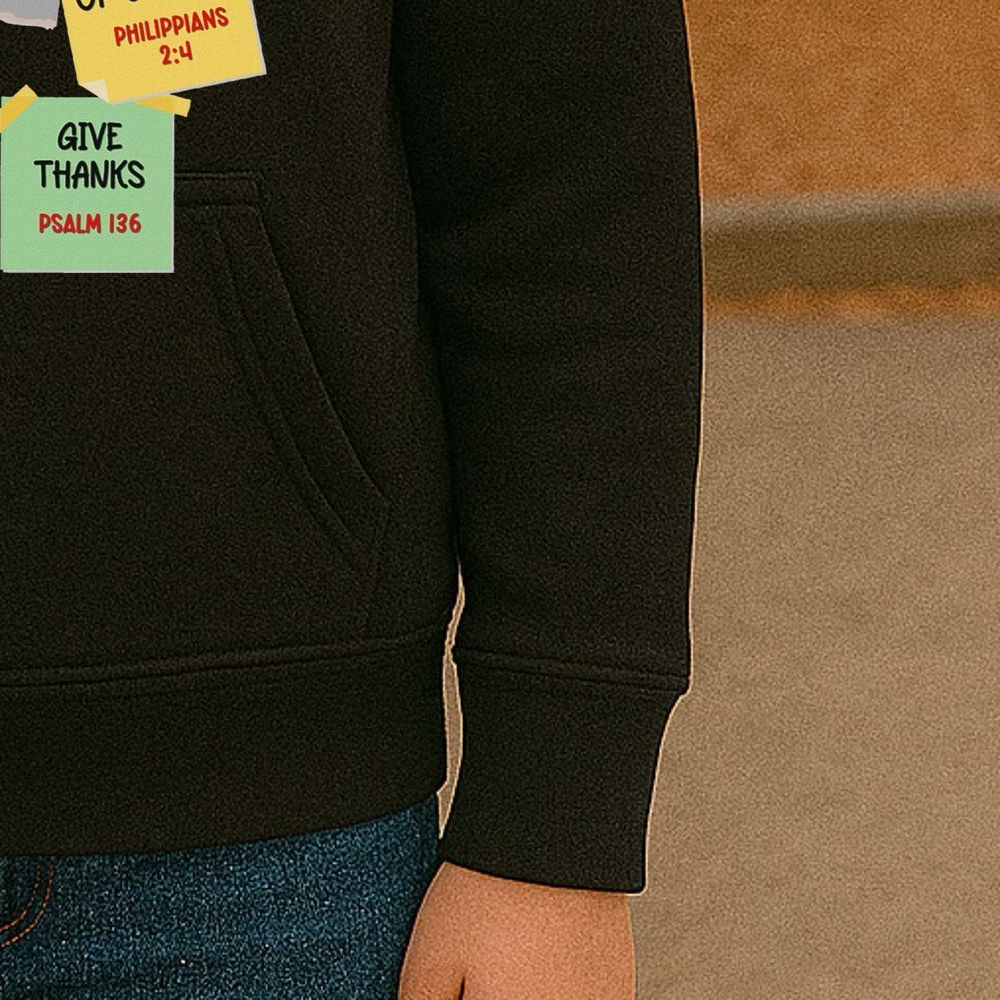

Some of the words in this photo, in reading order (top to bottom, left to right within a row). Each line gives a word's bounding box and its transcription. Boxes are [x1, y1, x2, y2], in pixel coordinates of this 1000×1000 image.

[113, 6, 229, 47] PHILIPPIANS
[159, 40, 193, 66] 2:4
[57, 121, 123, 152] GIVE
[34, 159, 146, 189] THANKS
[38, 212, 102, 235] PSALM
[107, 212, 142, 235] 136
